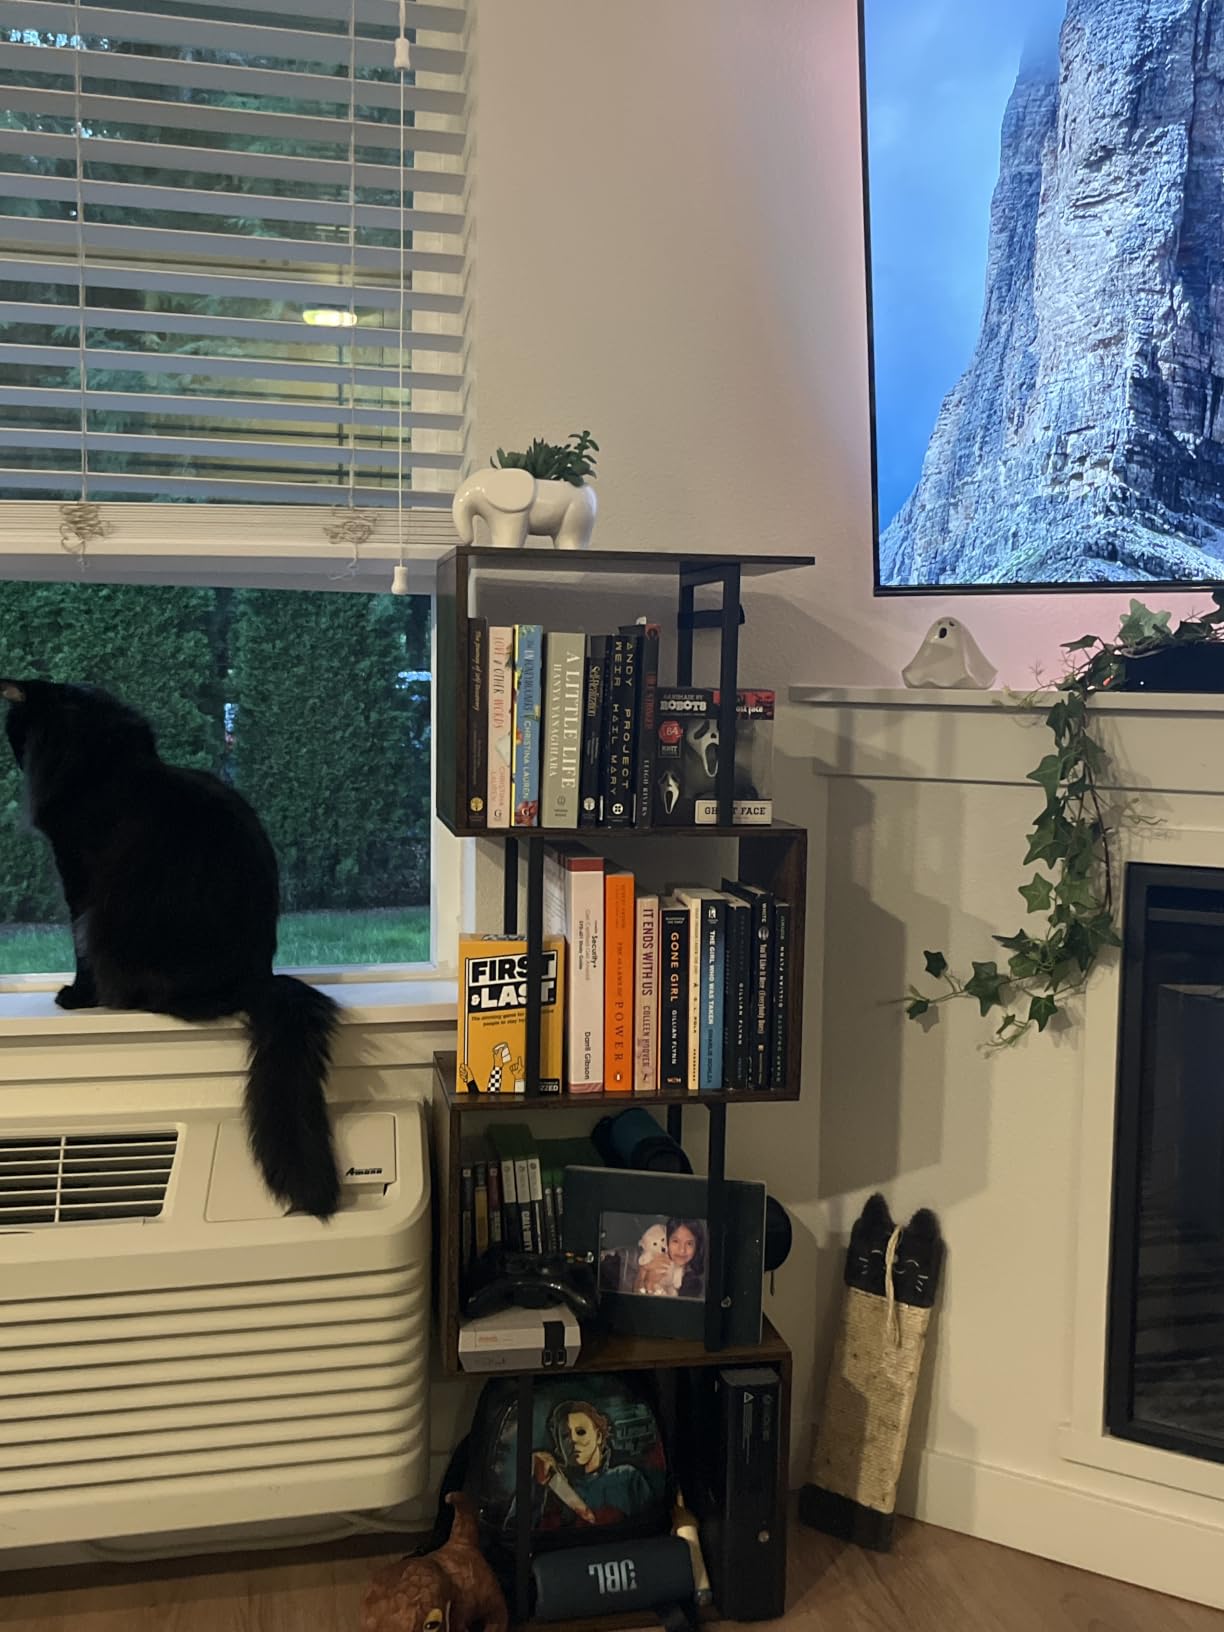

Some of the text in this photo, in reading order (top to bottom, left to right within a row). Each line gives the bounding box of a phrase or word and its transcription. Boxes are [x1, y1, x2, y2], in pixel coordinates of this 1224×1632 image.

[495, 636, 505, 656] LOVE
[566, 651, 580, 663] A
[613, 641, 634, 687] ANDY WEIR
[493, 668, 504, 695] OTHER
[493, 698, 504, 729] WORDS
[549, 663, 562, 777] HANYA YANAGIHARA
[563, 670, 580, 740] LITTLE
[660, 700, 707, 711] ROBOTS
[522, 720, 532, 800] CHRISTINA LAUREN
[609, 703, 620, 795] HAIL MARY
[621, 708, 631, 790] PROJECT
[561, 746, 577, 789] LIFE
[641, 787, 649, 817] RIVERS
[741, 806, 766, 816] FACE
[589, 935, 598, 969] Security+
[642, 908, 654, 996] IT ENDS WITH US
[670, 932, 679, 969] GONE
[670, 973, 679, 1002] GIRL
[708, 964, 716, 982] WHO
[707, 1000, 715, 1025] TAKEN
[615, 1001, 624, 1061] POWER
[642, 1039, 650, 1068] HOOVER
[588, 1559, 637, 1594] JBL
